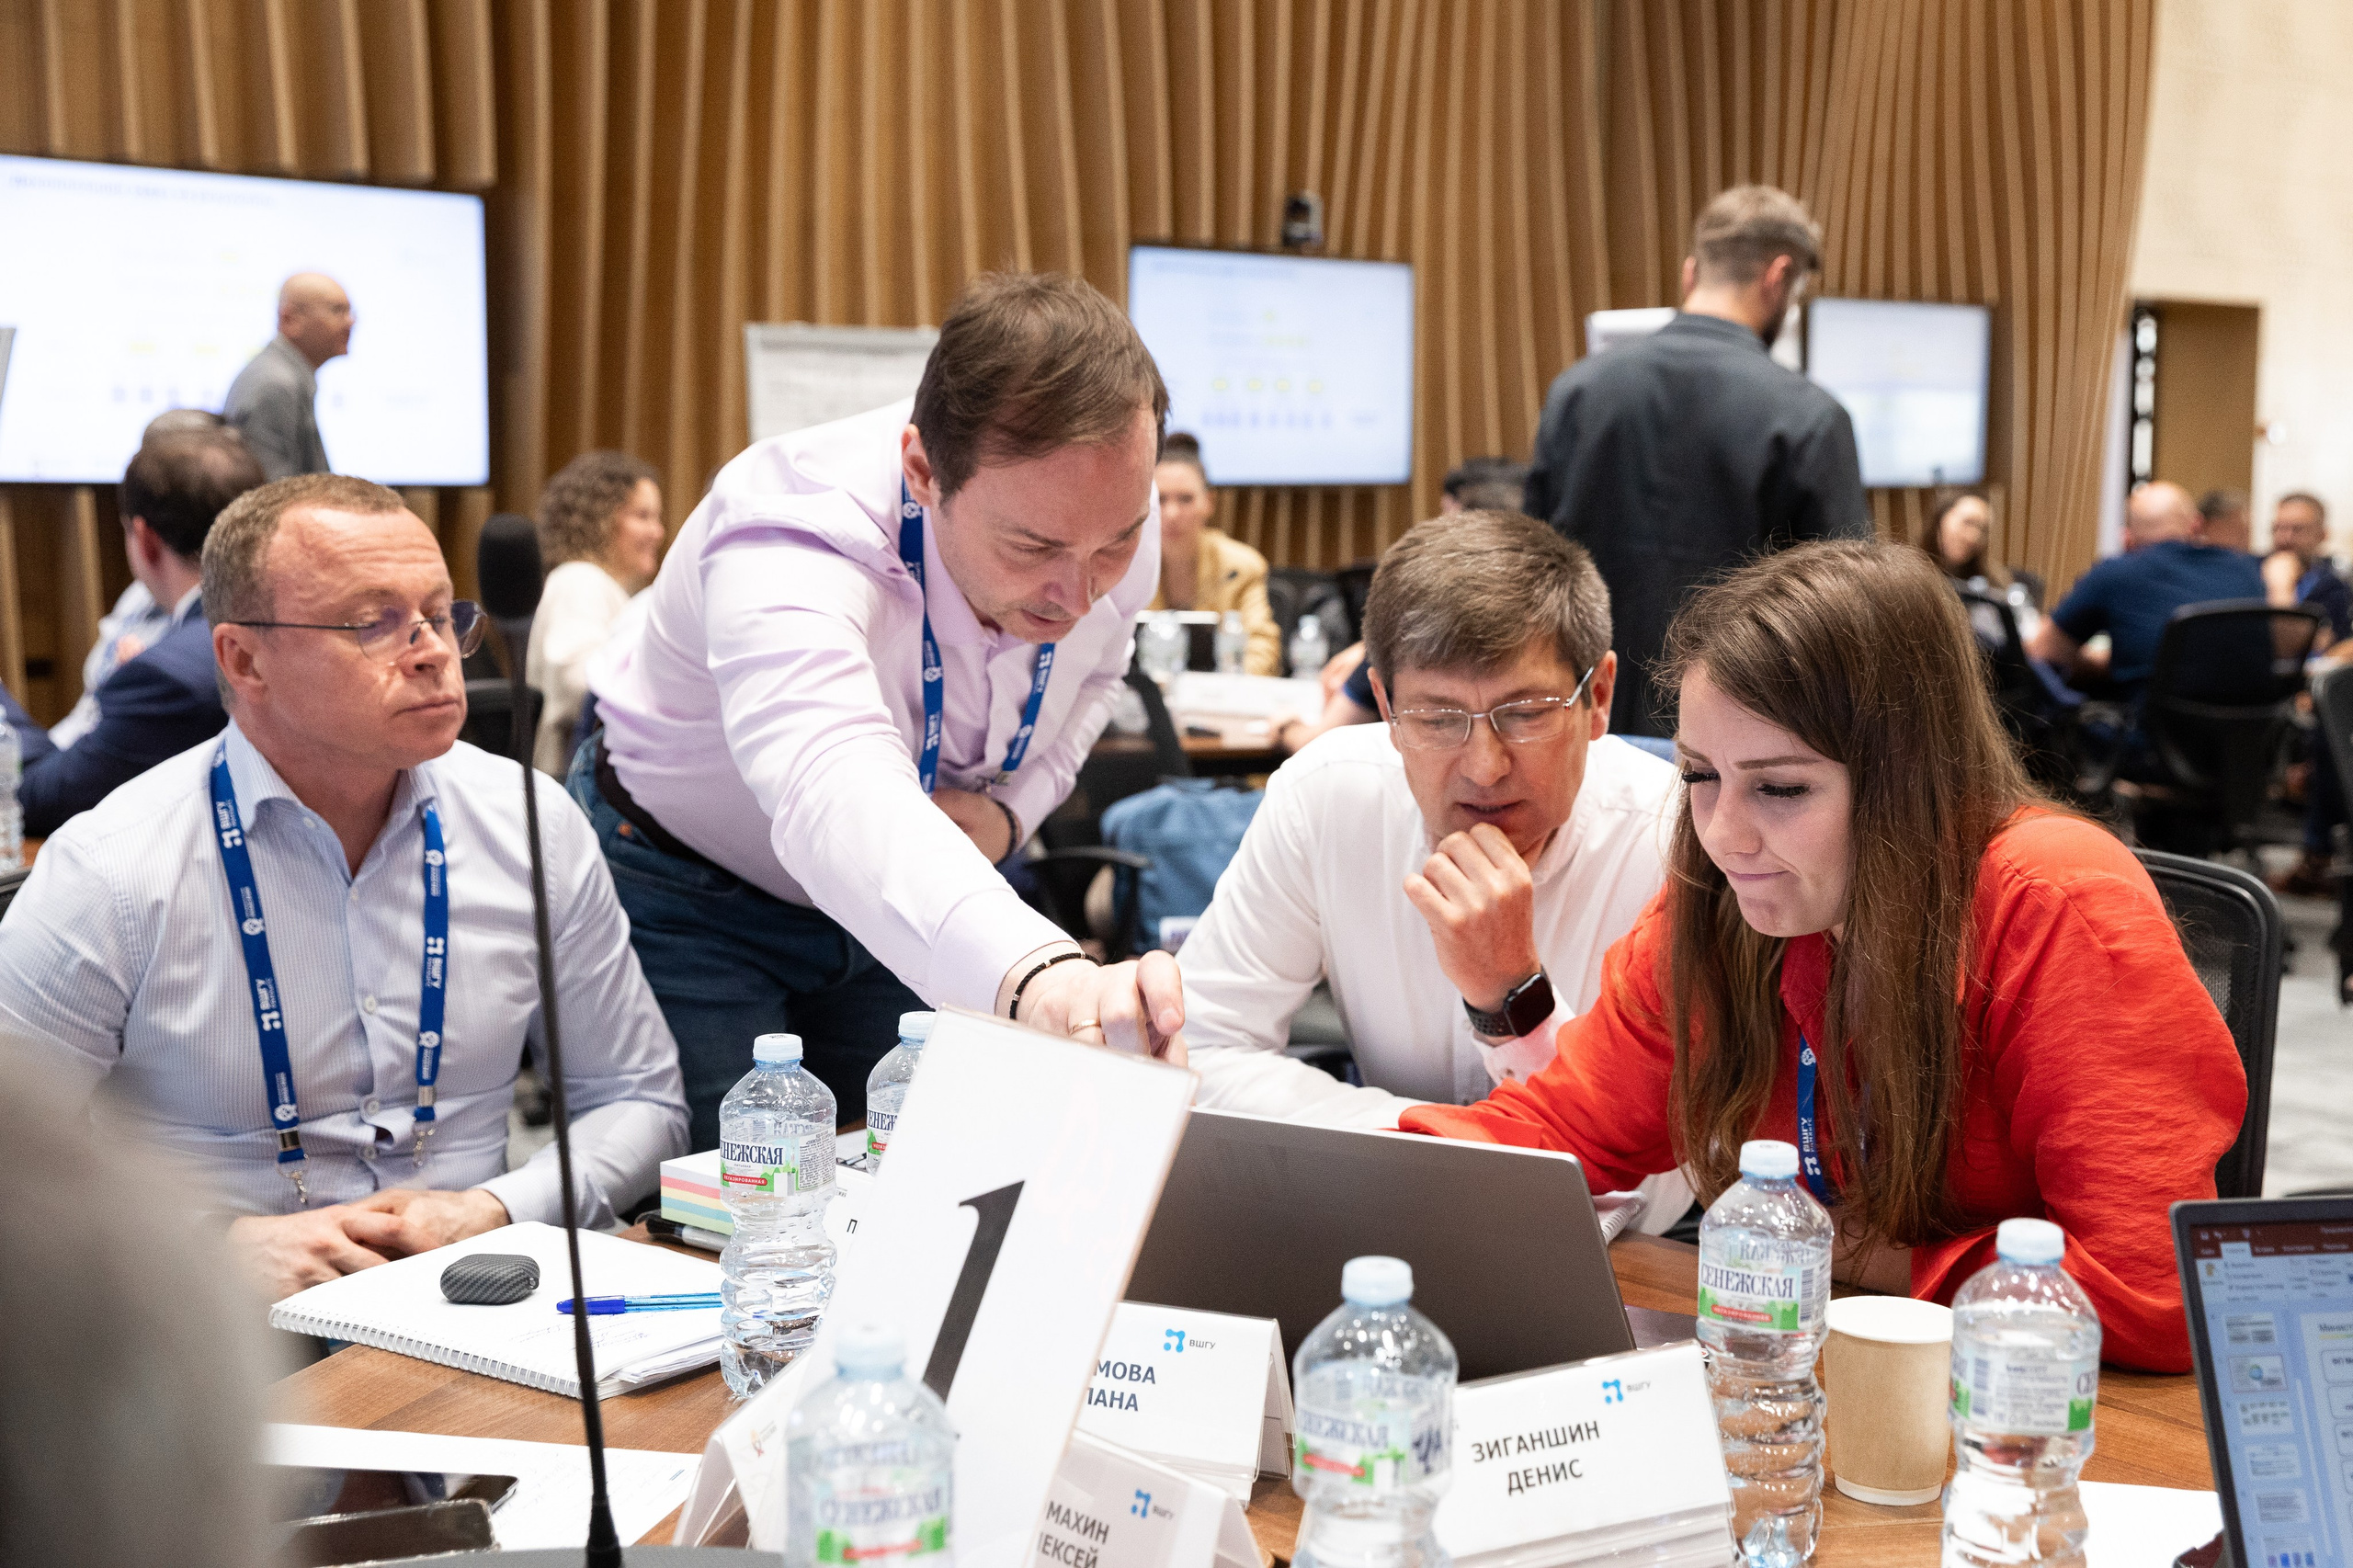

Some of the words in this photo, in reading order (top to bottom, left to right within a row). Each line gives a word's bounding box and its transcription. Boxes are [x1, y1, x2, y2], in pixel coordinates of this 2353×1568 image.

[921, 1179, 1026, 1407] 1
[1701, 1263, 1794, 1299] СЕНЕЖСКАЯ
[1188, 1338, 1216, 1349] ВШГУ
[1471, 1420, 1600, 1463] ЗИГАНШИН
[1506, 1459, 1584, 1496] ДЕНИС
[1045, 1500, 1109, 1545] МАХИН
